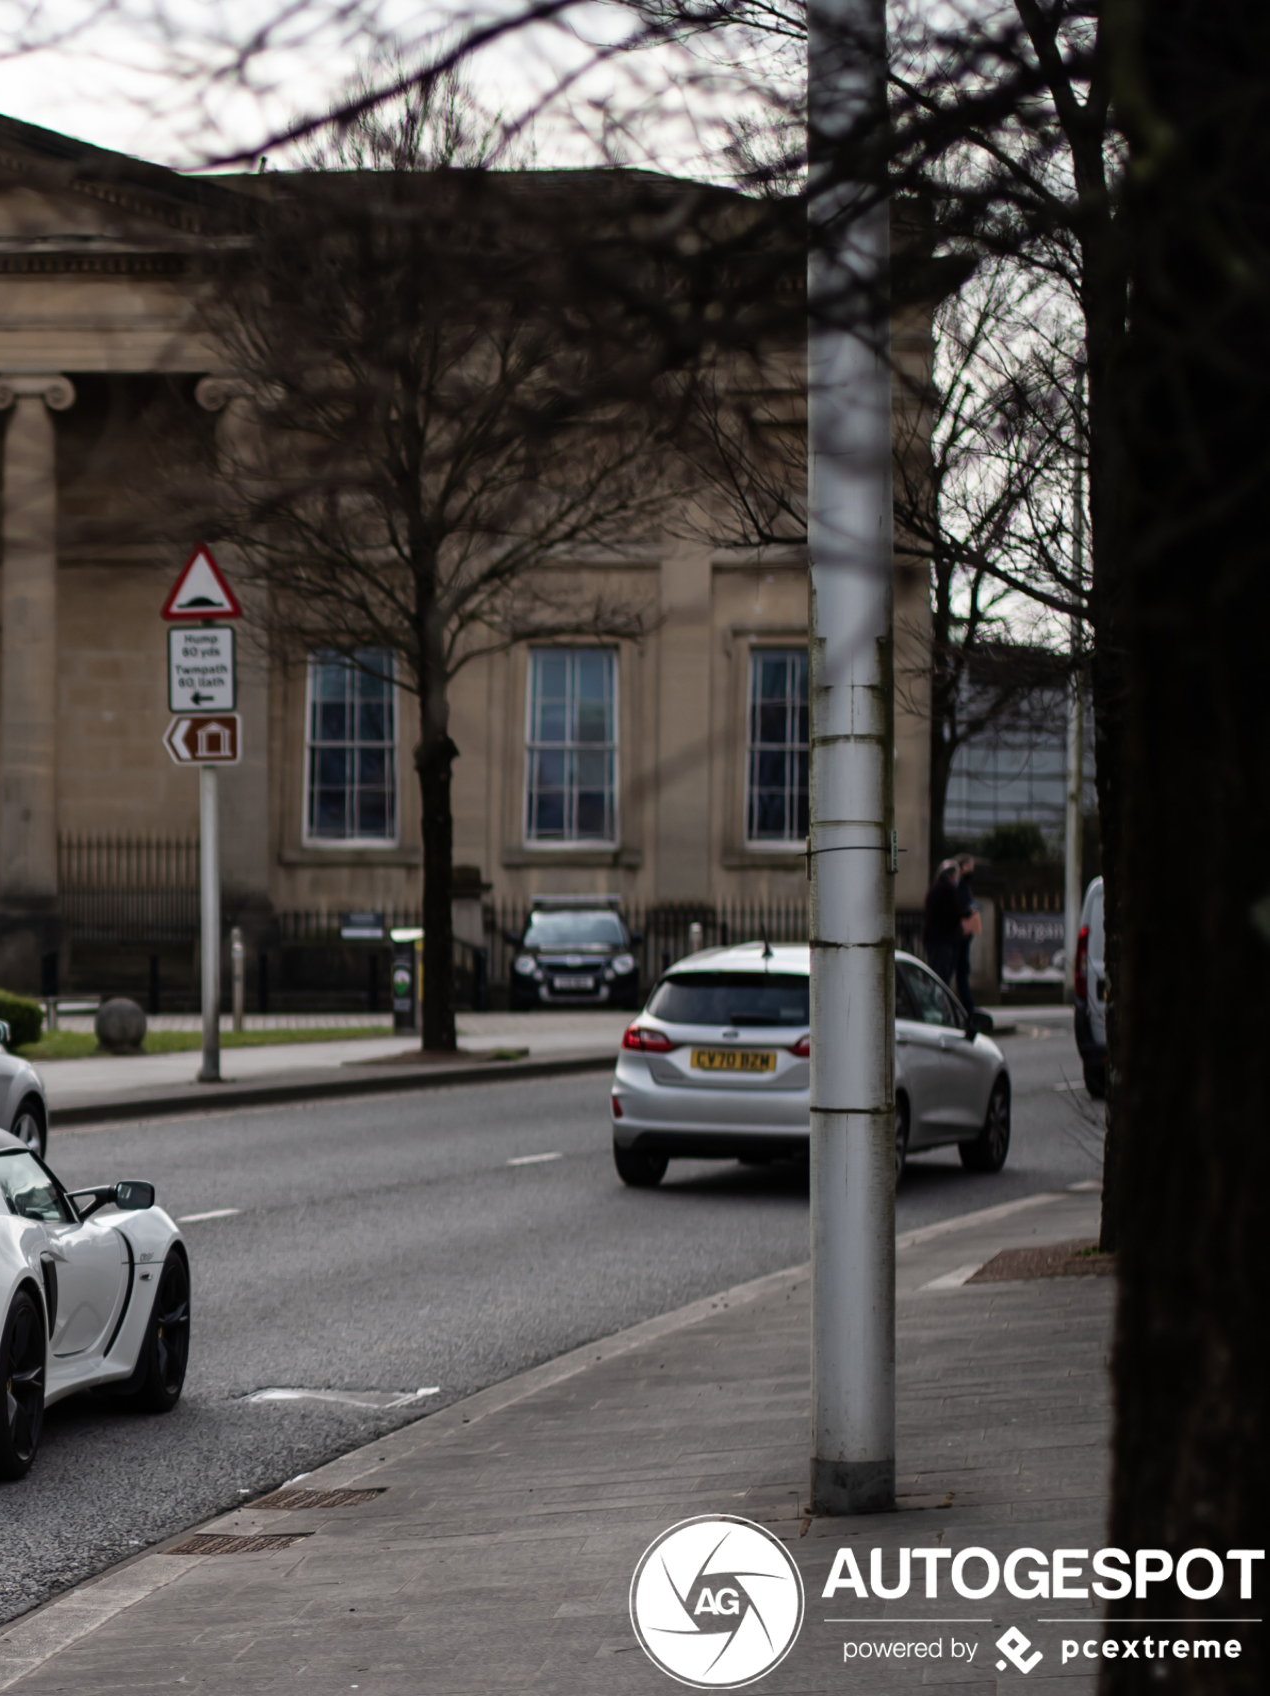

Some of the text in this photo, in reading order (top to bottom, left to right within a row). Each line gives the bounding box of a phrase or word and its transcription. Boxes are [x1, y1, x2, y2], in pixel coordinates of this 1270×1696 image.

[183, 634, 218, 645] Hump
[200, 646, 221, 659] yds
[175, 664, 228, 676] Twmpath
